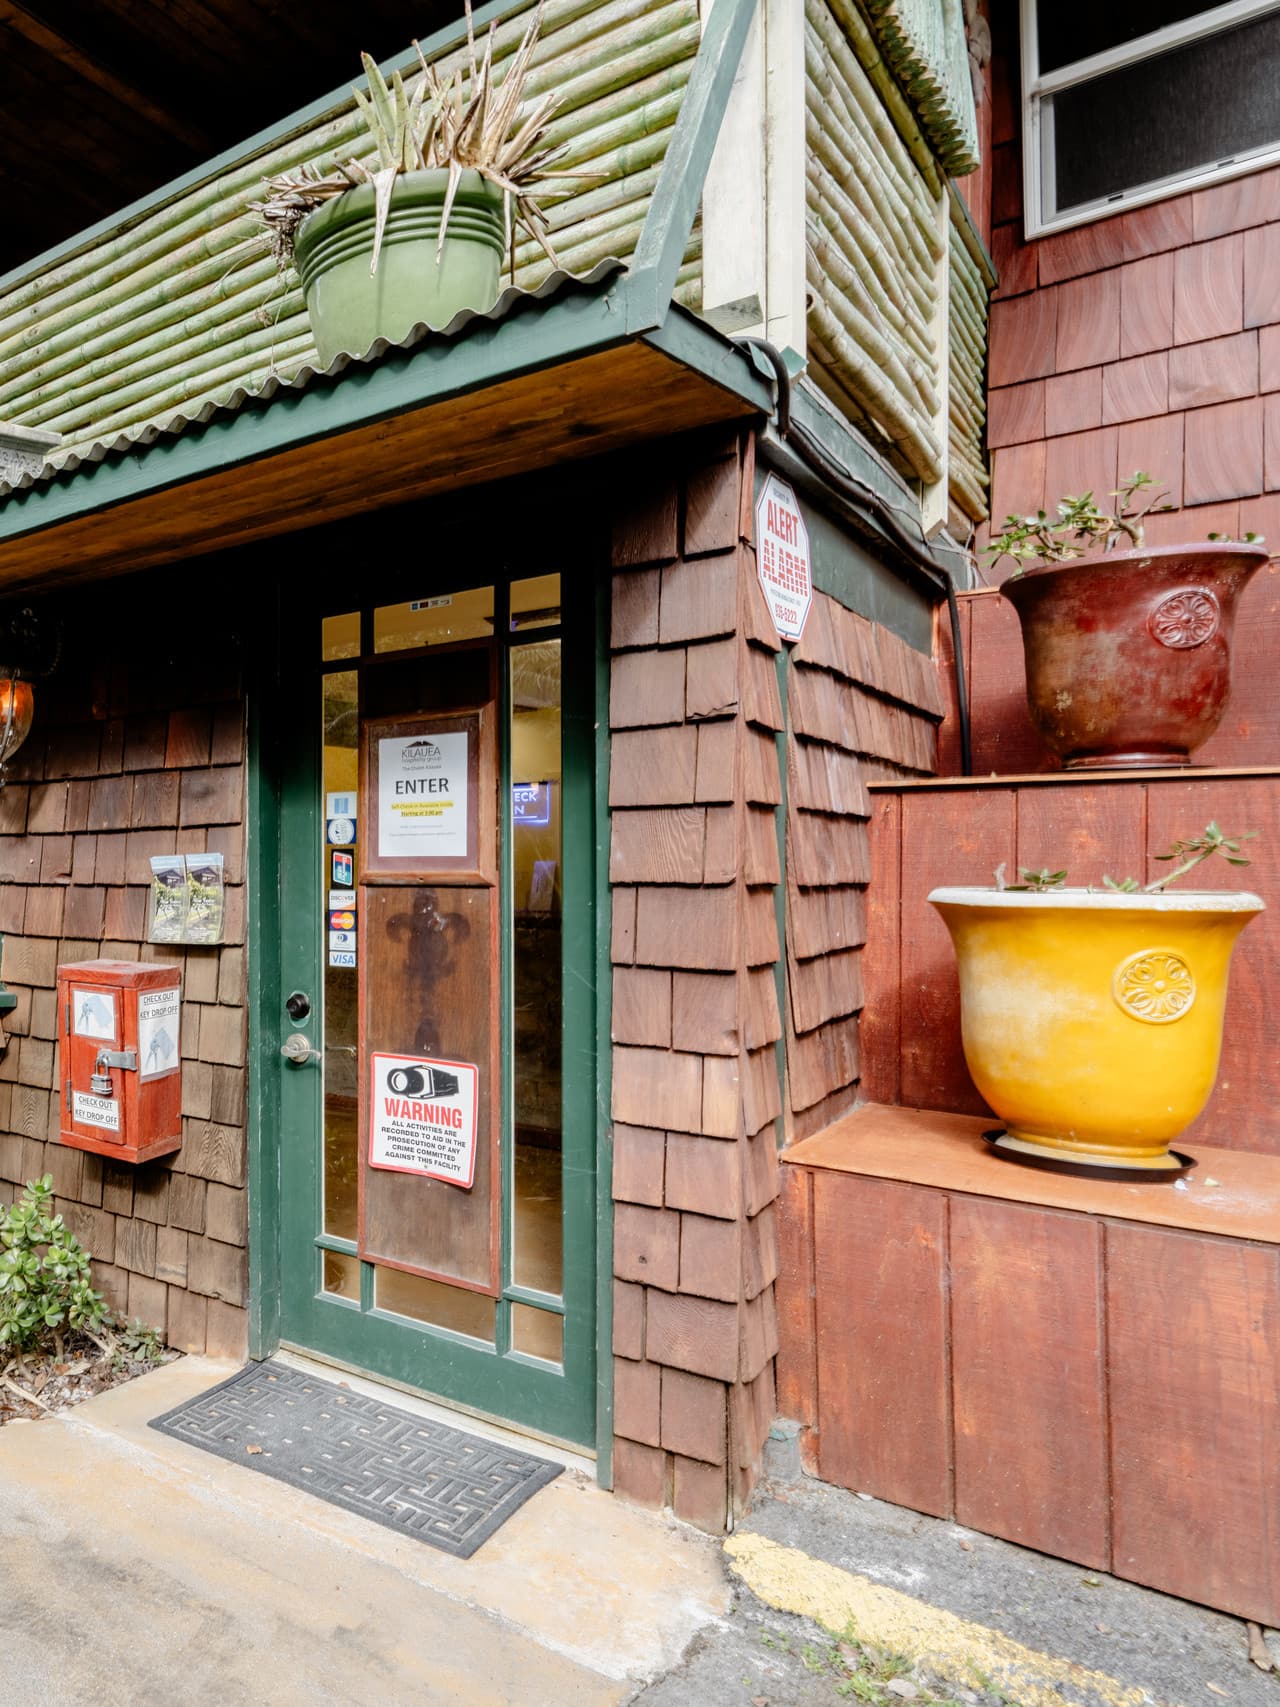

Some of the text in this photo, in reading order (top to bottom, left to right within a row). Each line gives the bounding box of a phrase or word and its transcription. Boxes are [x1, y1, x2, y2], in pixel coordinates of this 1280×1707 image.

[768, 499, 798, 547] ALERT
[401, 746, 441, 758] KILAUEA
[395, 778, 449, 795] ENTER
[514, 791, 537, 802] ECK
[514, 805, 525, 815] N
[332, 954, 354, 964] VISA
[144, 992, 174, 1004] CHECK OUT
[152, 1007, 166, 1017] DROP
[168, 1005, 178, 1015] OFF
[78, 1096, 112, 1109] CHECK OUT
[75, 1109, 117, 1124] KEY DROP OFF
[384, 1098, 462, 1129] WARNING
[406, 1122, 443, 1134] ACTIVITIES
[381, 1126, 419, 1138] RECORDED
[454, 1140, 466, 1148] THE
[387, 1135, 436, 1149] PROSECUTION
[448, 1147, 460, 1155] ANY
[392, 1144, 456, 1162] CRIME COMMITTED
[385, 1151, 461, 1172] AGAINST THIS FACILITY
